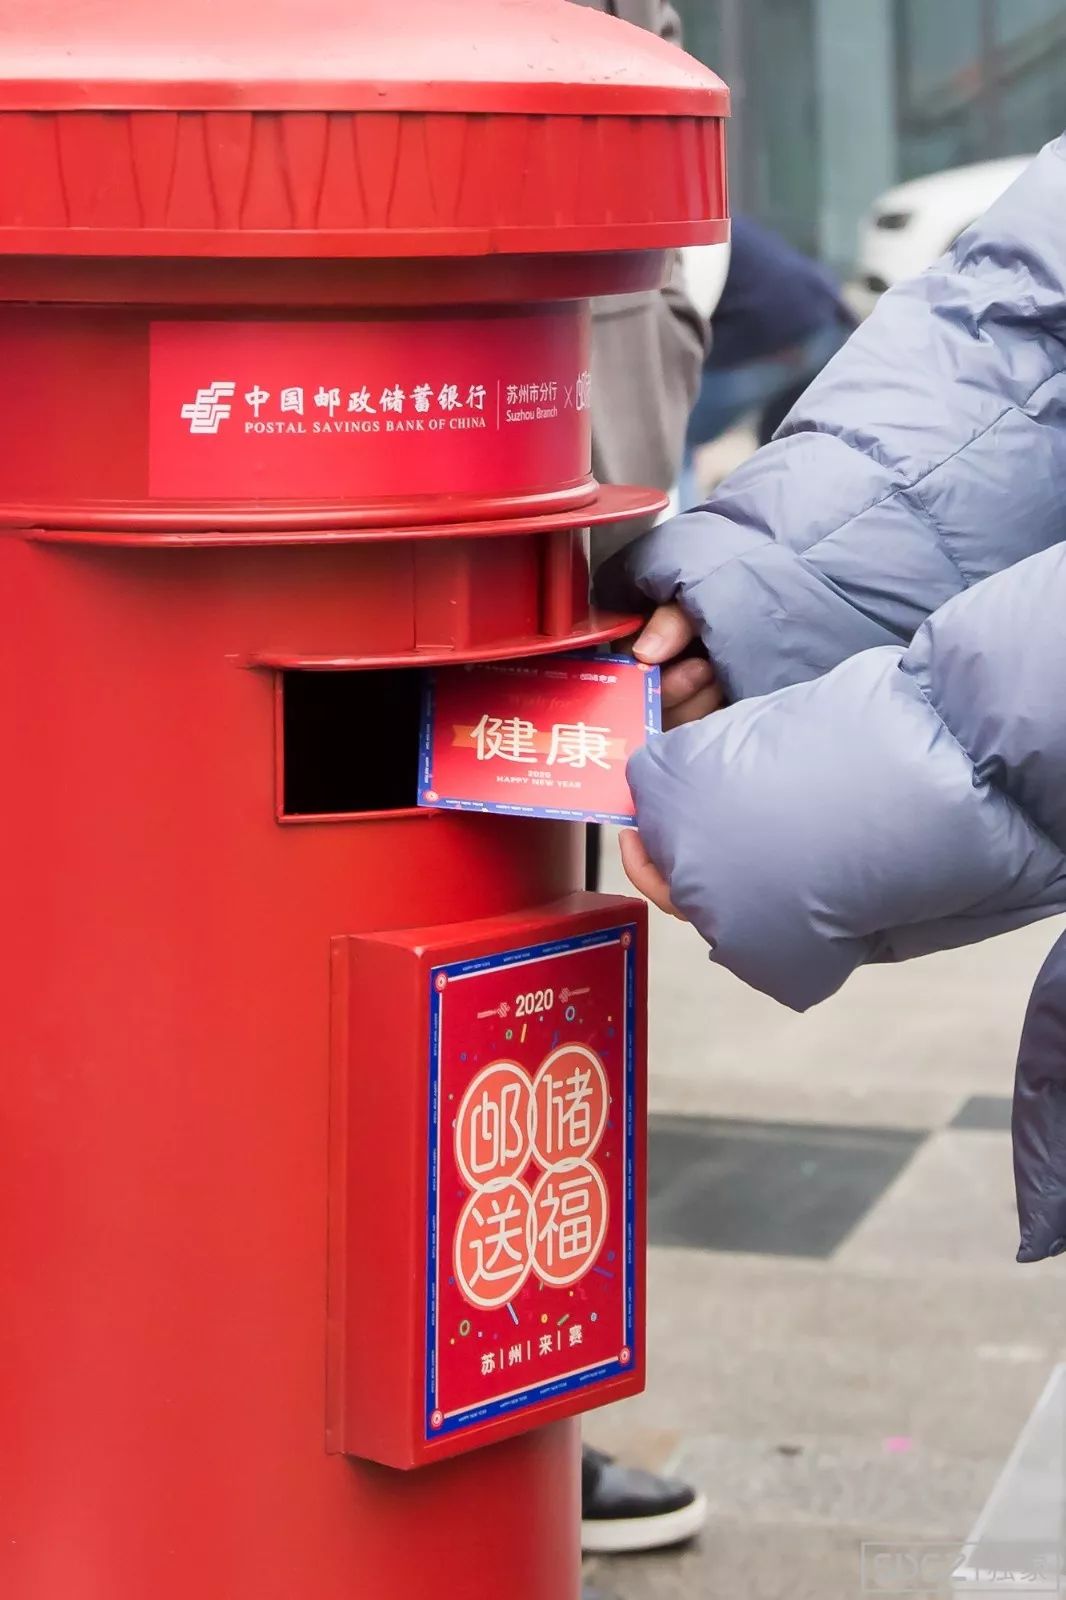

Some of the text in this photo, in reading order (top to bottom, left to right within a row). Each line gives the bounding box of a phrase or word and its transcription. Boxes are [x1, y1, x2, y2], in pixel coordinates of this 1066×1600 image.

[245, 383, 487, 417] 中国邮政储蓄银行
[506, 381, 557, 404] 苏州市分行
[245, 417, 486, 433] POSTAL SAVINGS BANK OF CHINA
[506, 405, 558, 421] Suzhou Branch
[470, 714, 612, 769] 健康
[496, 775, 582, 789] HAPPY NEW YEAR
[515, 988, 554, 1018] 2020
[468, 1175, 593, 1288] 送福
